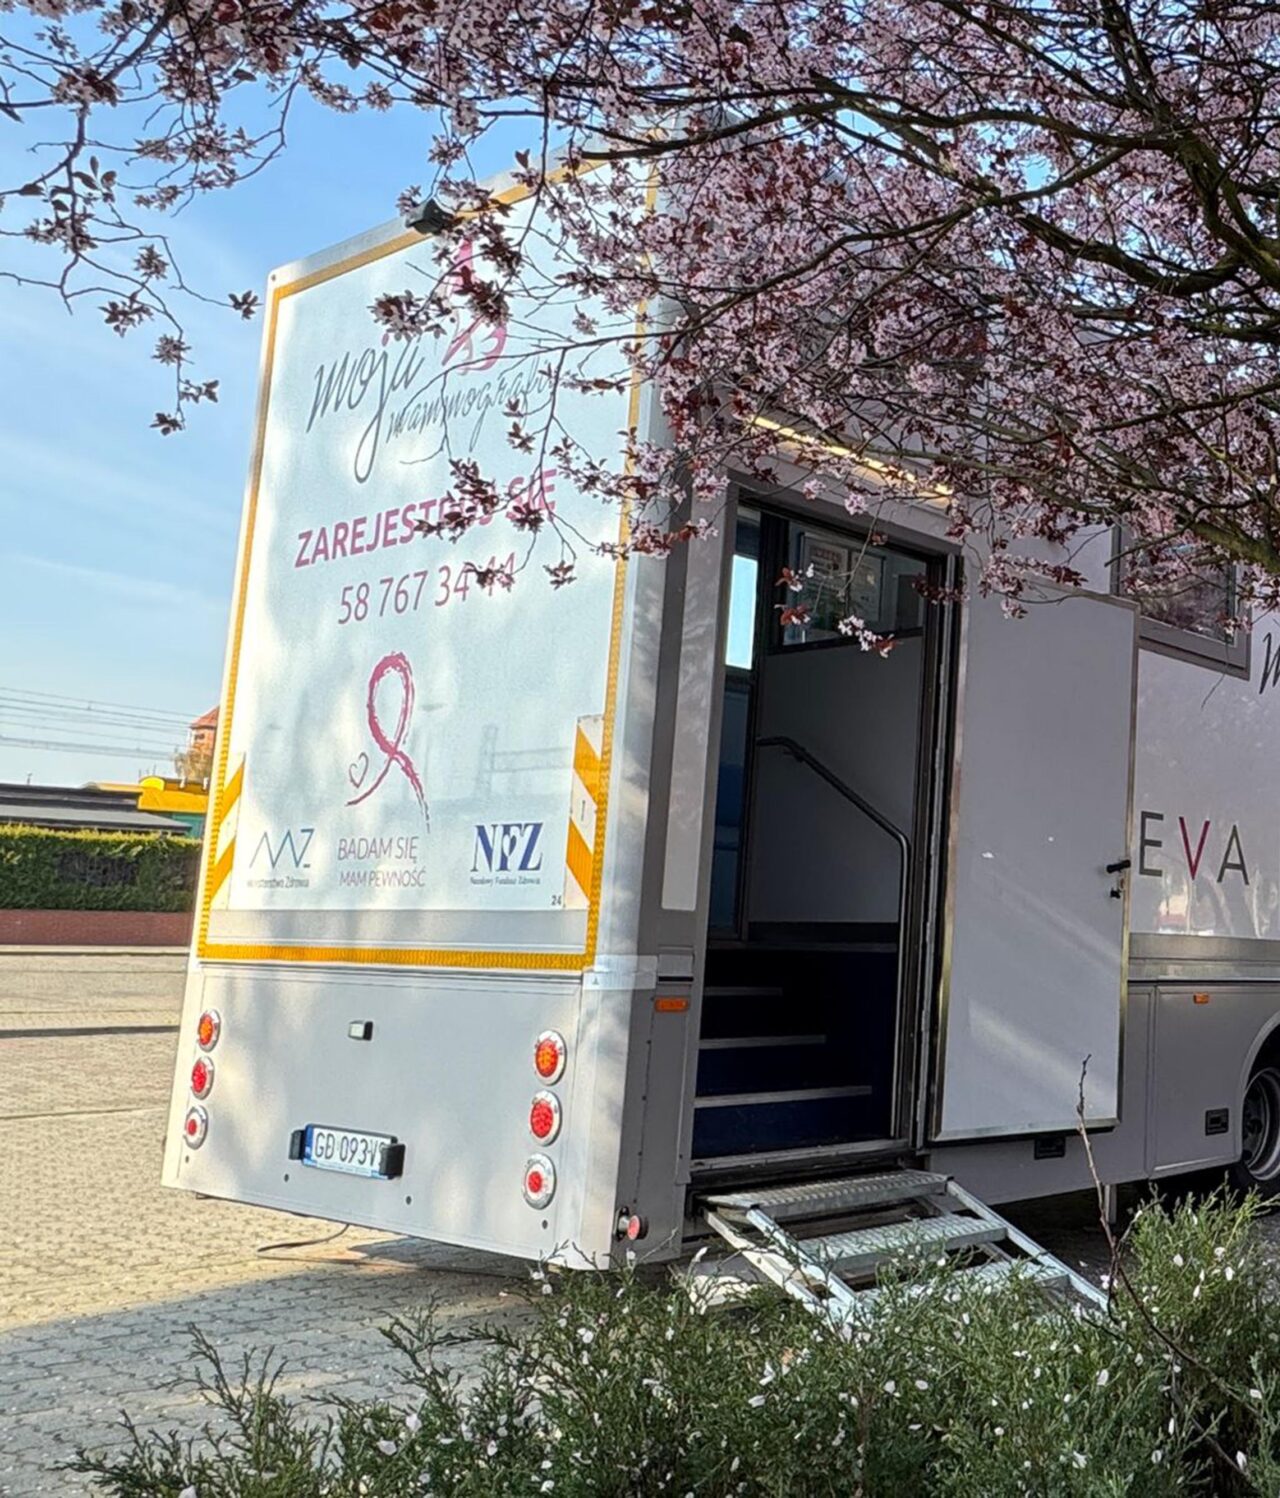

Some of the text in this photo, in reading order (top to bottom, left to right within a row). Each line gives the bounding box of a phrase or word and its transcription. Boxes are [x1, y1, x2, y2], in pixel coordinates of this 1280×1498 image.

[385, 355, 560, 452] mammografi
[294, 490, 493, 568] ZAREJEST
[337, 583, 370, 625] 58
[378, 566, 429, 616] 767
[434, 562, 470, 607] 34
[338, 835, 419, 864] BADAM SIĘ
[470, 822, 543, 872] NFZ
[1138, 810, 1250, 886] EVA
[339, 865, 427, 888] MAM PEWNOŚĆ
[550, 894, 562, 906] 24
[315, 1132, 336, 1160] GD
[339, 1135, 388, 1168] 093V
